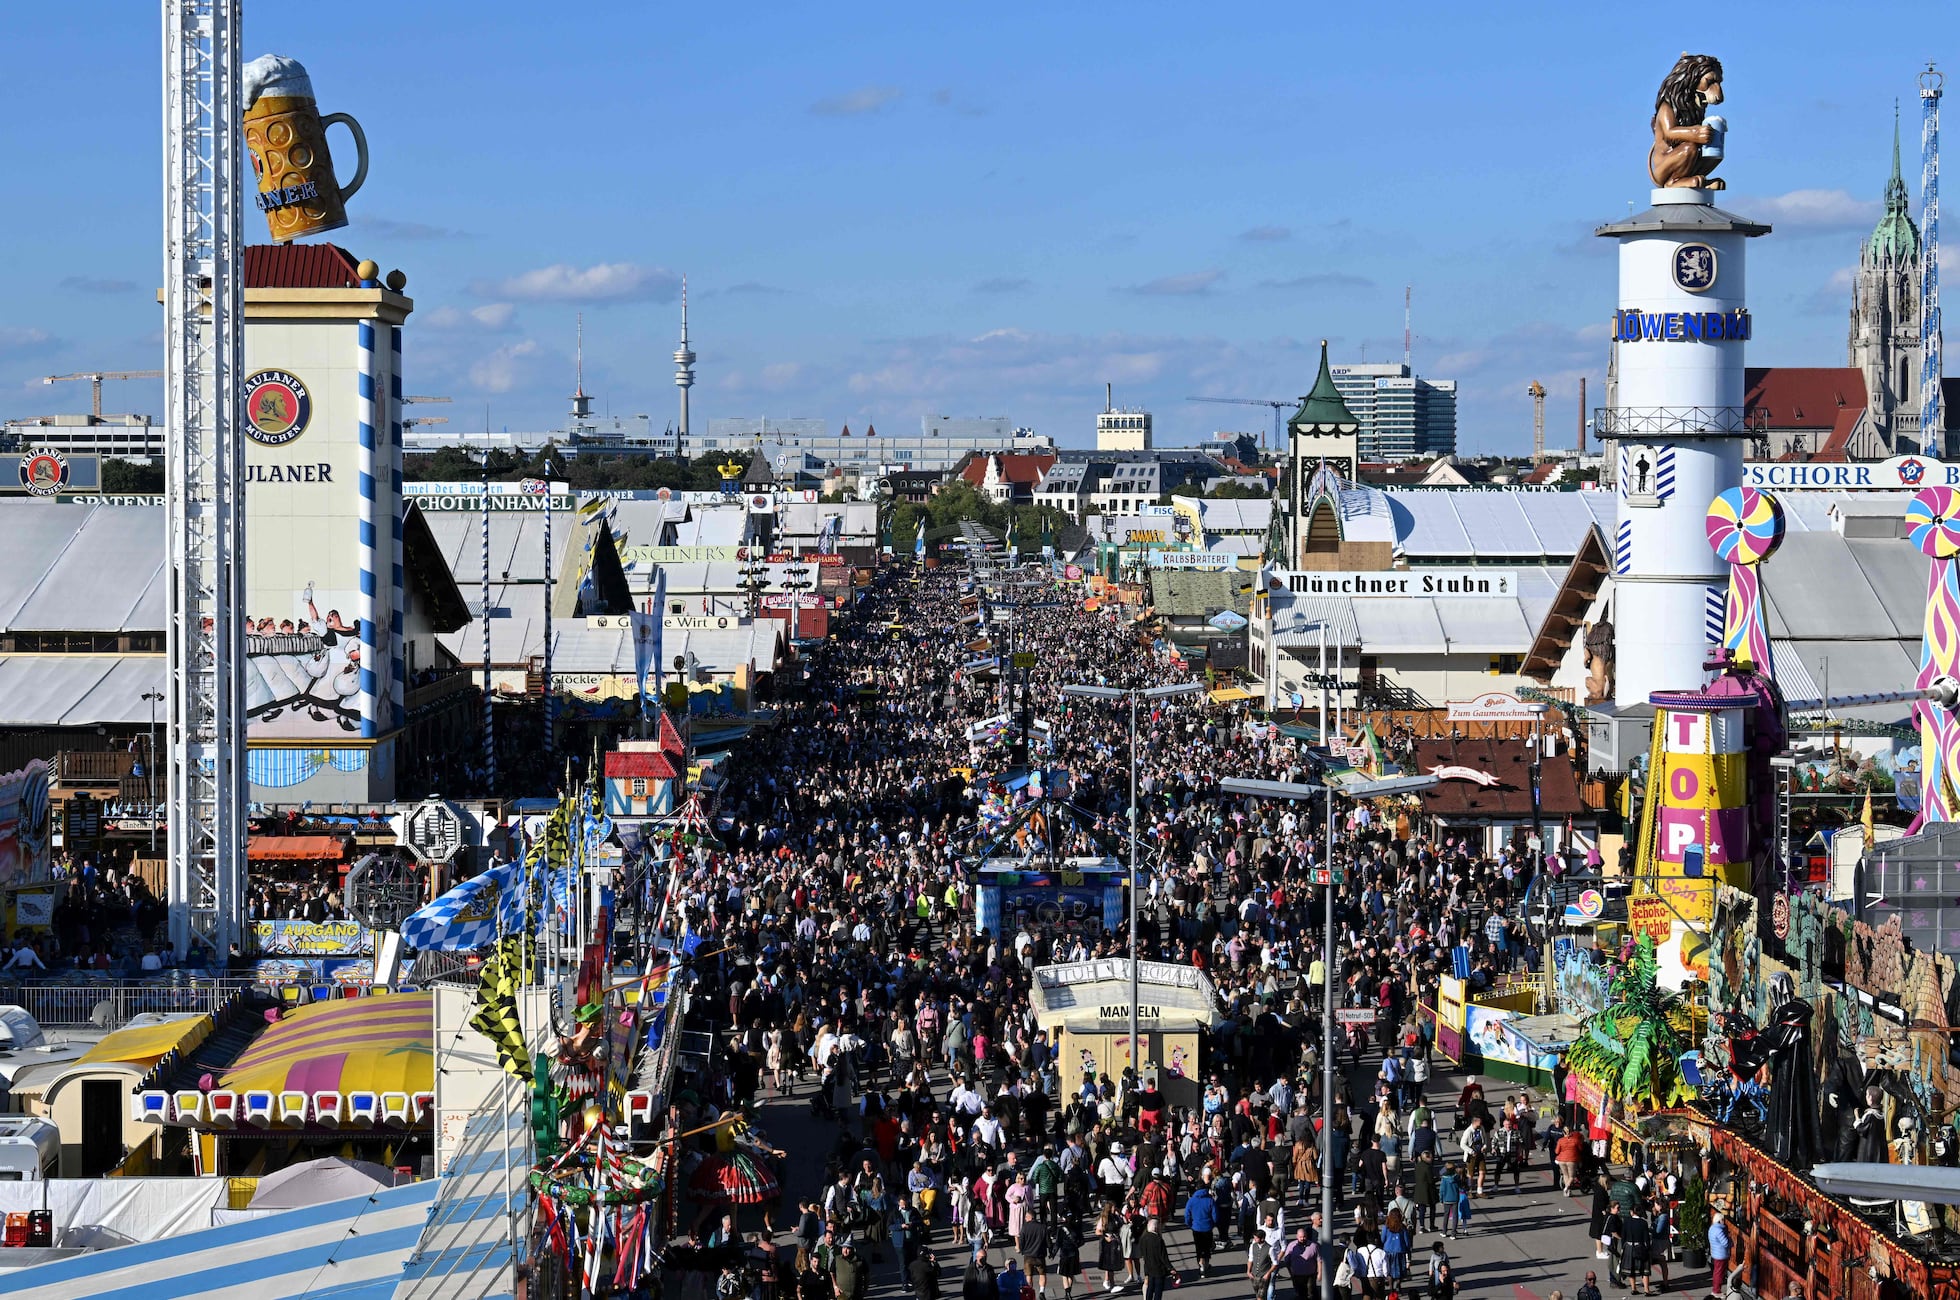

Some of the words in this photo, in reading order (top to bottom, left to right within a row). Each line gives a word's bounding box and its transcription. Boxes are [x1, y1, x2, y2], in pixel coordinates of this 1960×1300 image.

[1616, 308, 1752, 341] LÖWENBRÄ
[245, 372, 306, 400] AULANER
[1378, 379, 1389, 388] BR
[245, 424, 301, 443] MÜNCHEN
[21, 447, 67, 468] PAULANER
[25, 480, 65, 496] MÜNCHEN
[435, 483, 454, 494] der
[460, 483, 503, 495] Bayrn
[581, 490, 634, 499] PAULANER
[1163, 553, 1229, 564] KALBSBRATEREI
[1289, 575, 1408, 593] Münchner
[1422, 575, 1490, 593] Stubn
[677, 617, 708, 628] Wirt
[1453, 709, 1471, 717] Zum
[1663, 878, 1698, 903] Spin
[1631, 906, 1669, 919] Schoko-
[282, 924, 359, 936] AUSGANG
[1100, 1006, 1160, 1018] MANELN
